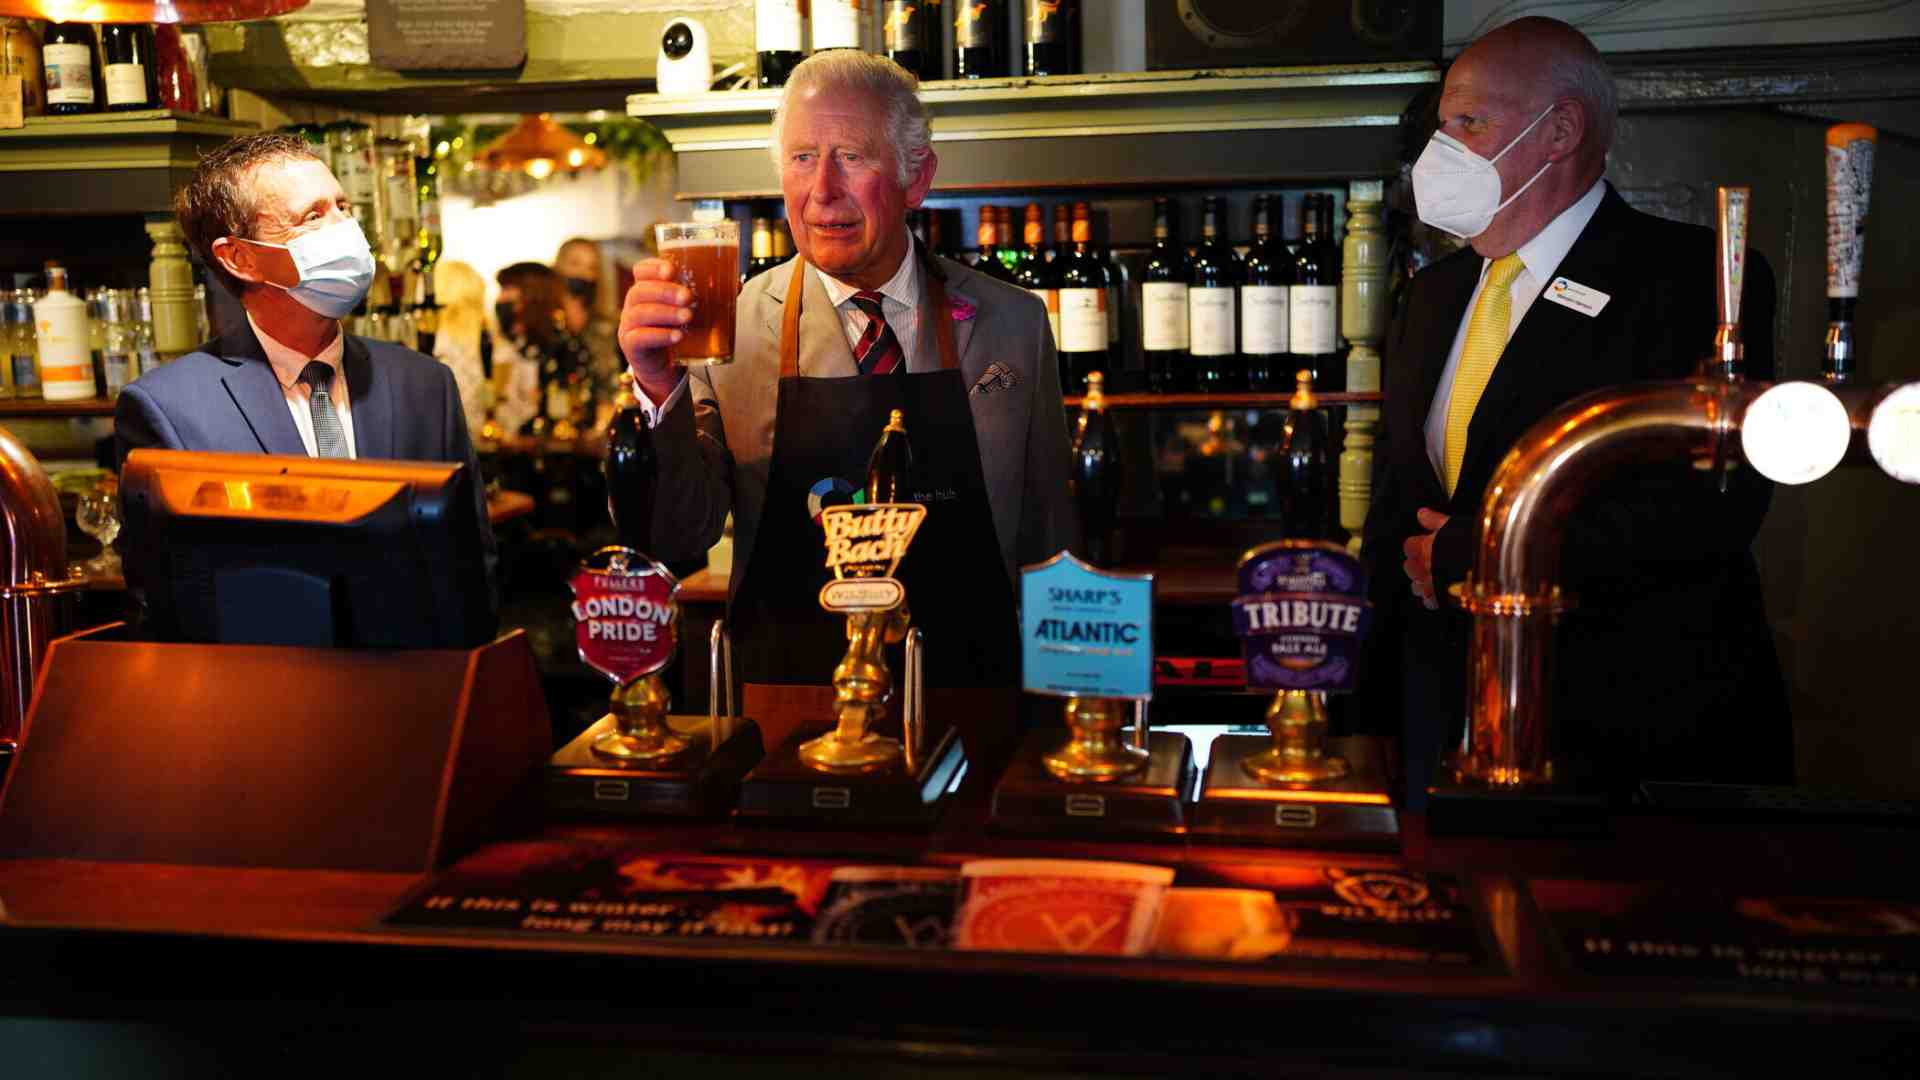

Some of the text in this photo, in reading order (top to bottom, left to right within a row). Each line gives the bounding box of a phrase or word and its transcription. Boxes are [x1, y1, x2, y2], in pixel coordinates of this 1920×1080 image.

[827, 508, 921, 540] Butty
[825, 534, 907, 567] Bach
[1048, 587, 1122, 605] SHARP'S
[571, 596, 671, 624] LONDON
[1243, 600, 1360, 632] TRIBUTE
[588, 620, 657, 641] PRIDE
[1034, 619, 1140, 643] ATLANTIC
[461, 897, 520, 911] this
[521, 914, 593, 933] long
[602, 919, 667, 936] may
